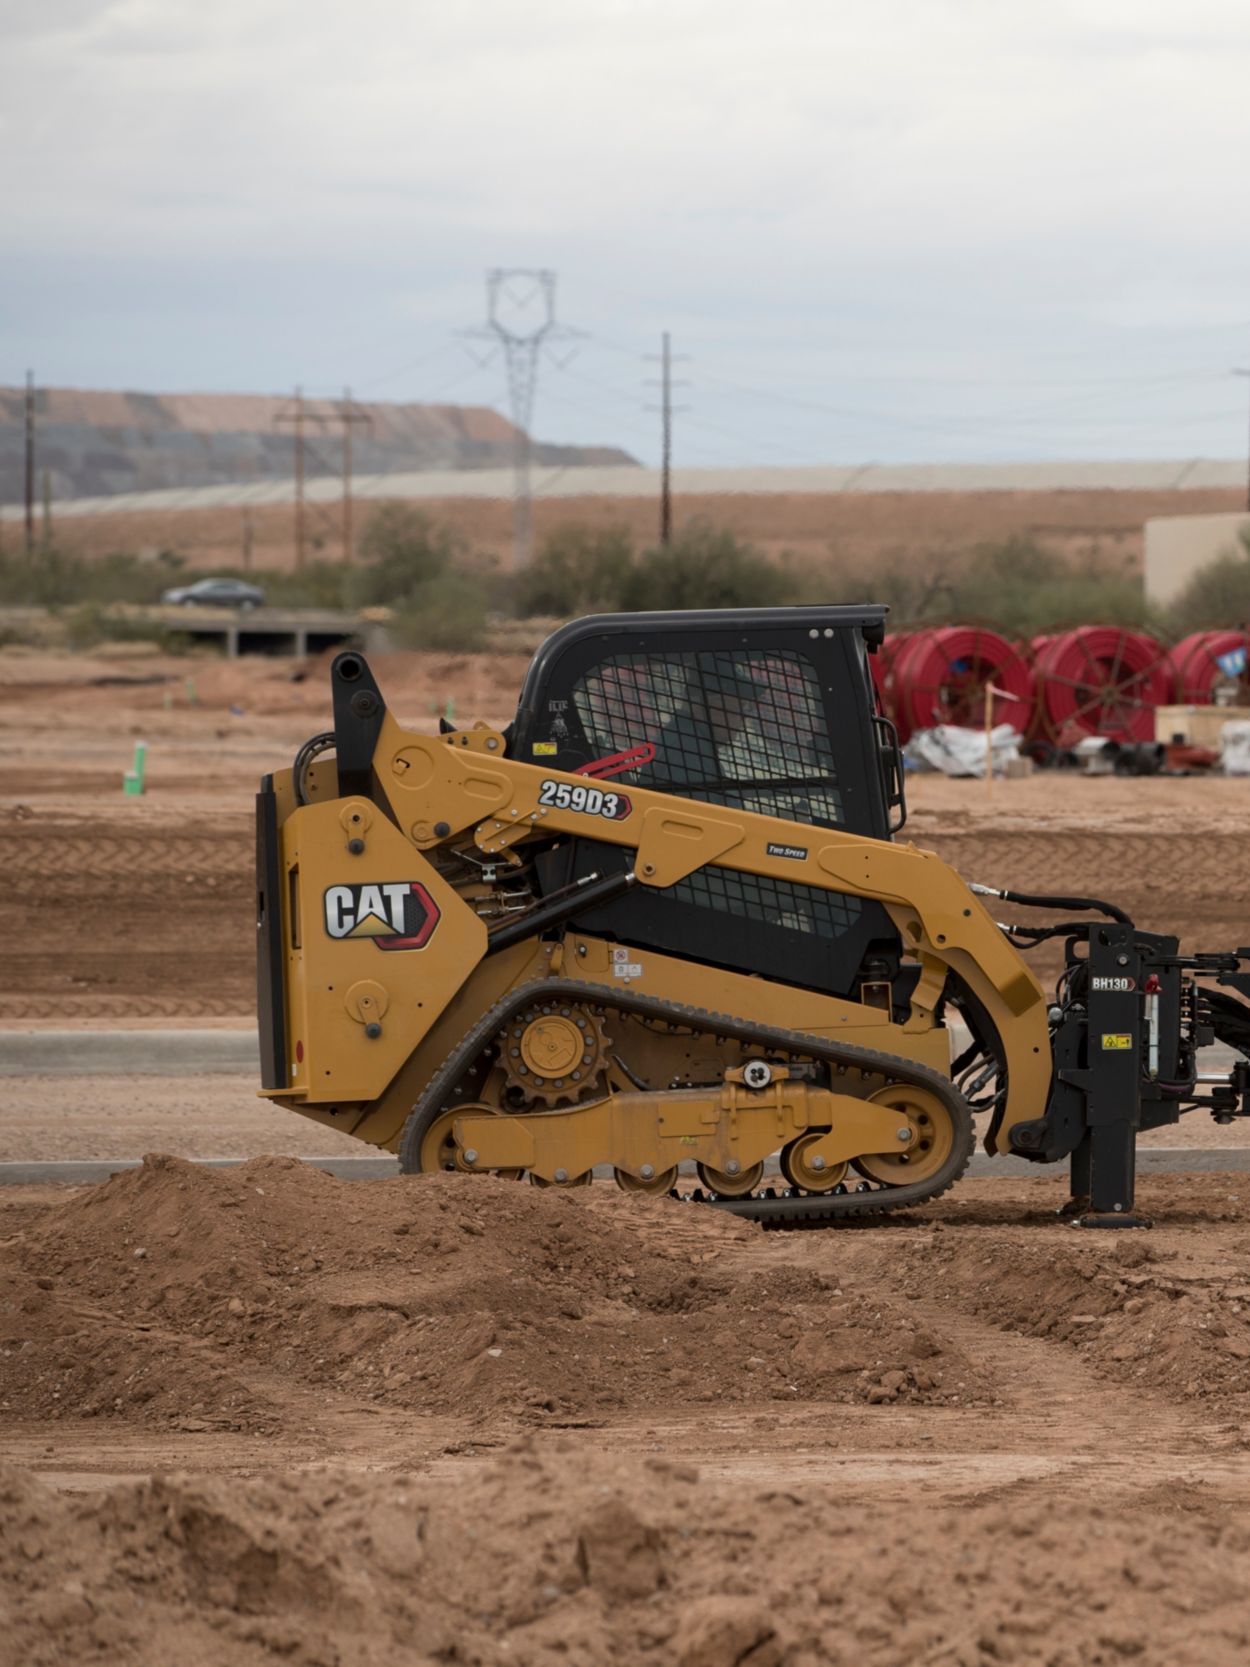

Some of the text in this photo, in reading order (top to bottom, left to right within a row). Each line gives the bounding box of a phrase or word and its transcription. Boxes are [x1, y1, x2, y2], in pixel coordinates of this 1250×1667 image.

[540, 780, 618, 820] 259D3
[325, 884, 411, 937] CAT
[1092, 977, 1128, 990] BH130
